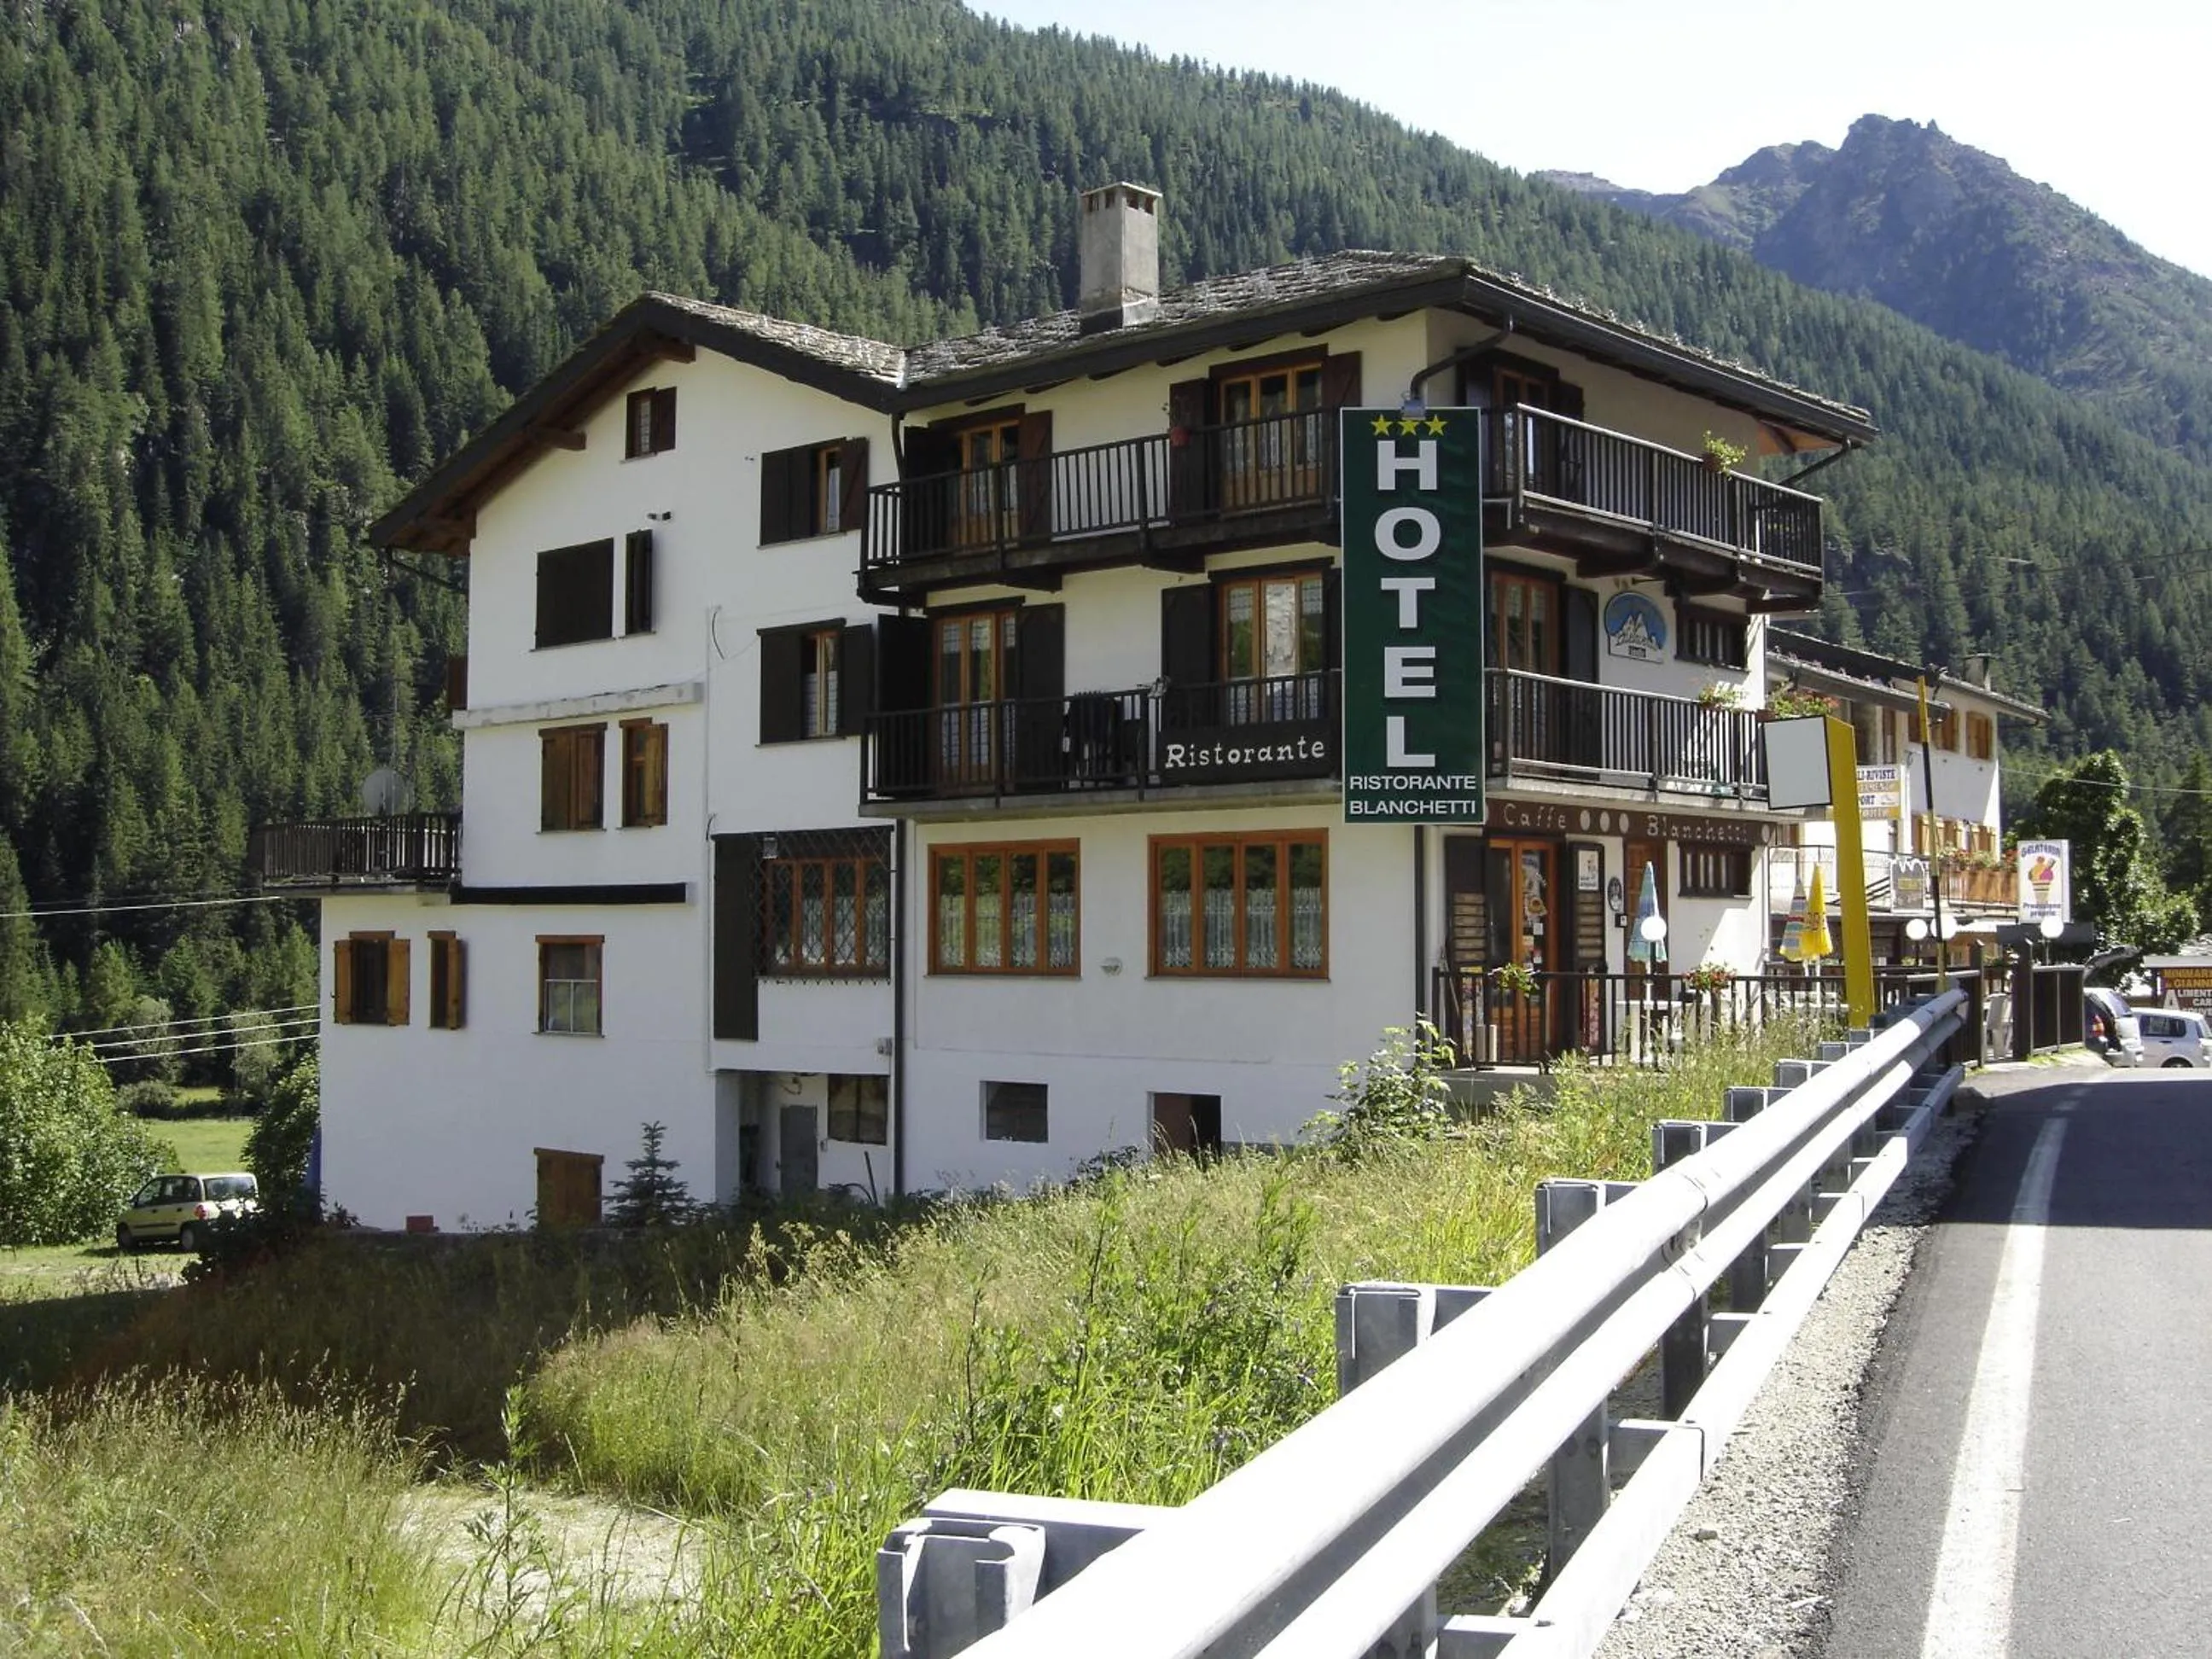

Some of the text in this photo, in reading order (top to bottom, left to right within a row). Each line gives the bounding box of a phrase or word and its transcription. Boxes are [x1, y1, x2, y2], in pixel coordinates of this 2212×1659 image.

[1375, 439, 1441, 767] HOTEL
[1165, 736, 1325, 768] Ristorante
[1350, 775, 1476, 790] RISTORANTE
[1350, 800, 1476, 815] BLANCHETTI
